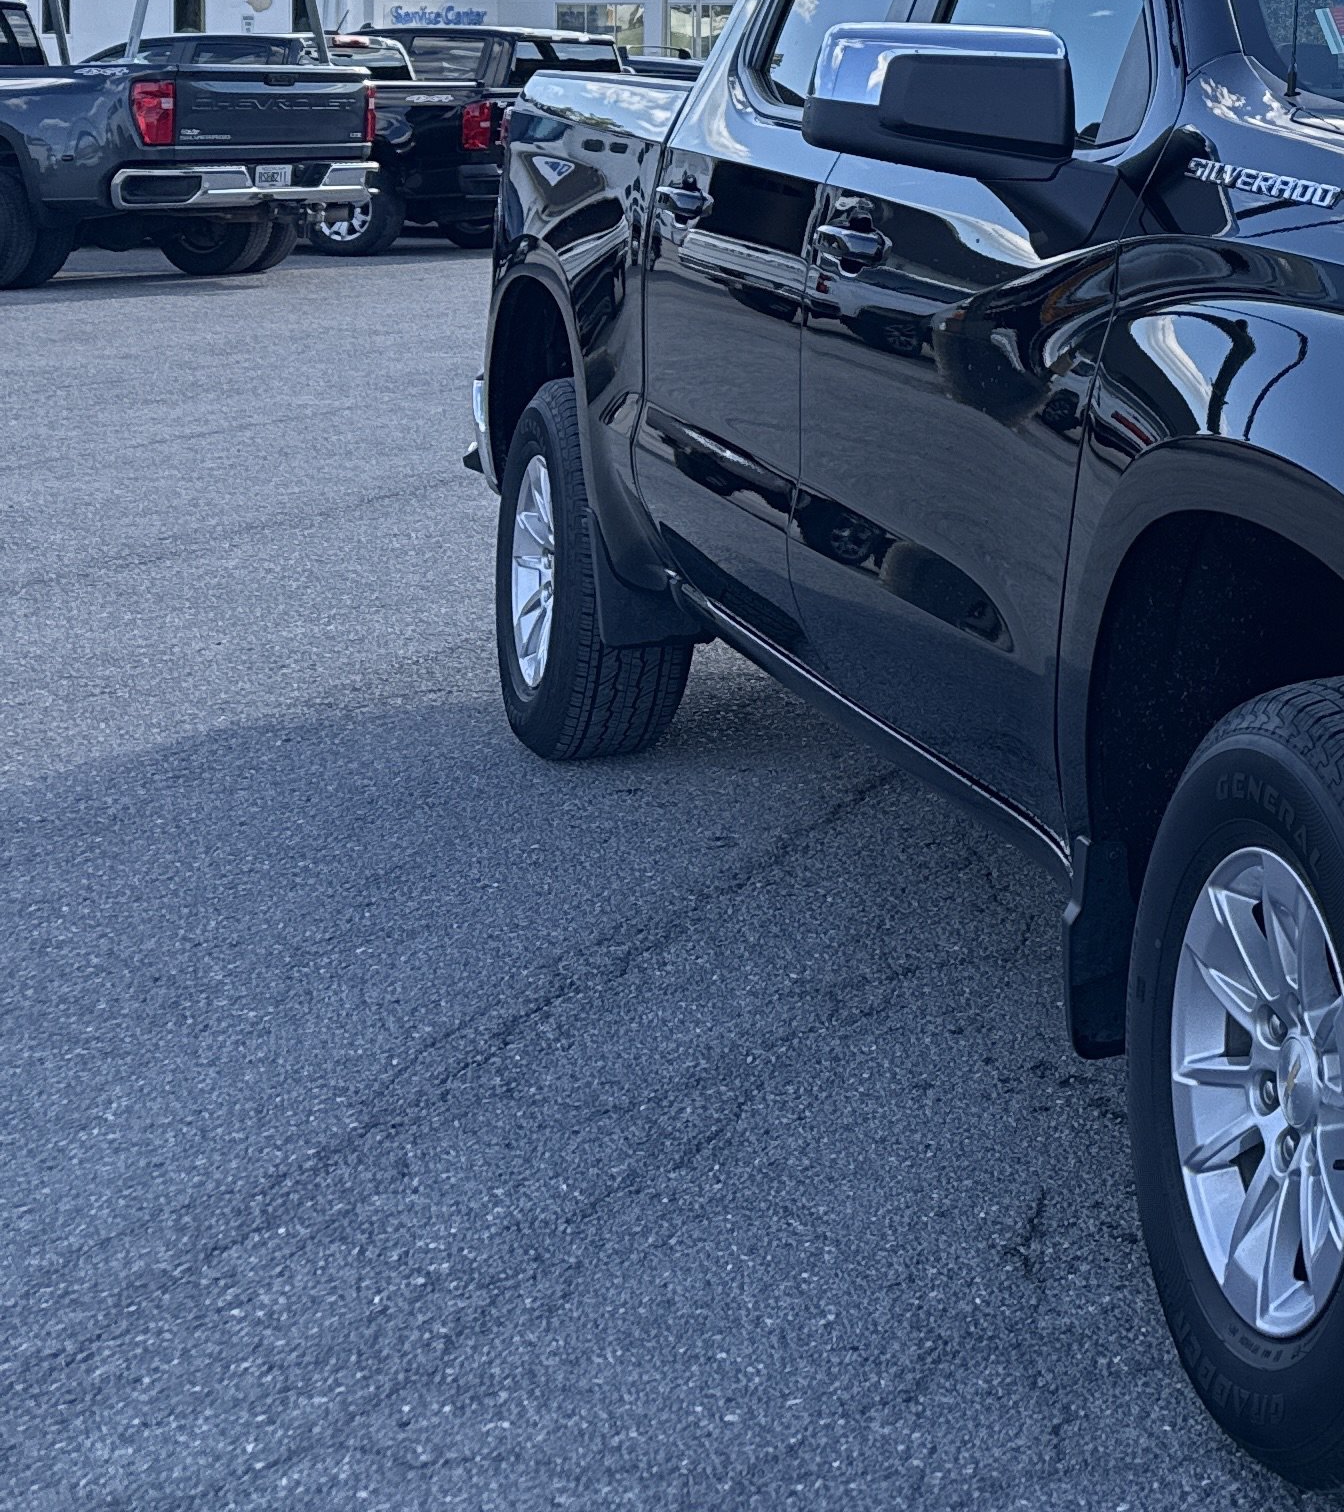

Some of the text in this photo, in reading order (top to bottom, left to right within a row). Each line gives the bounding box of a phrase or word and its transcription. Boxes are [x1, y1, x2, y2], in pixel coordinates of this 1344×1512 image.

[390, 5, 487, 25] Service Center
[191, 99, 356, 110] CHEVROLET
[1184, 157, 1343, 210] SILVERADO
[1215, 771, 1320, 881] GENERAL
